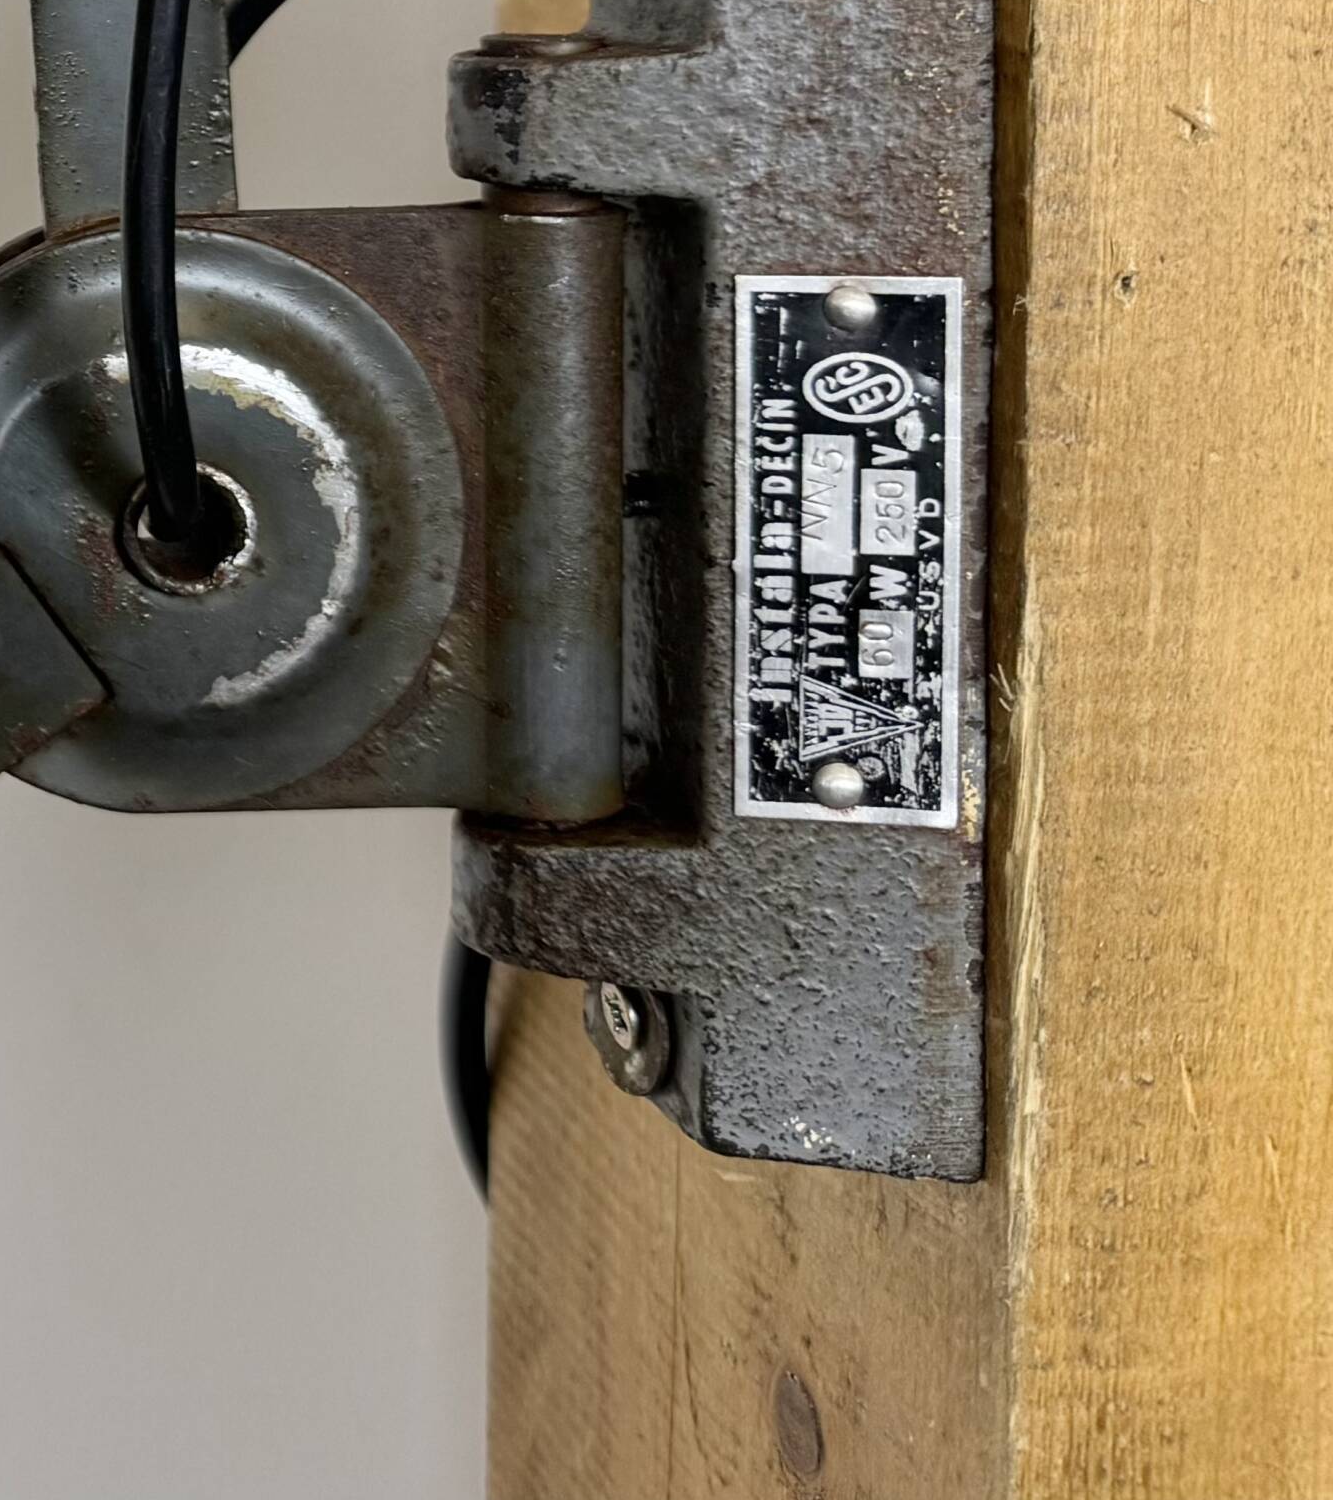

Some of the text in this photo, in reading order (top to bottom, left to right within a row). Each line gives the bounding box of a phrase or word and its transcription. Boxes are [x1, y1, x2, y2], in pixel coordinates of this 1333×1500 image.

[872, 445, 908, 465] V
[871, 565, 906, 599] W
[807, 579, 847, 670] TYPA
[860, 620, 895, 667] 60
